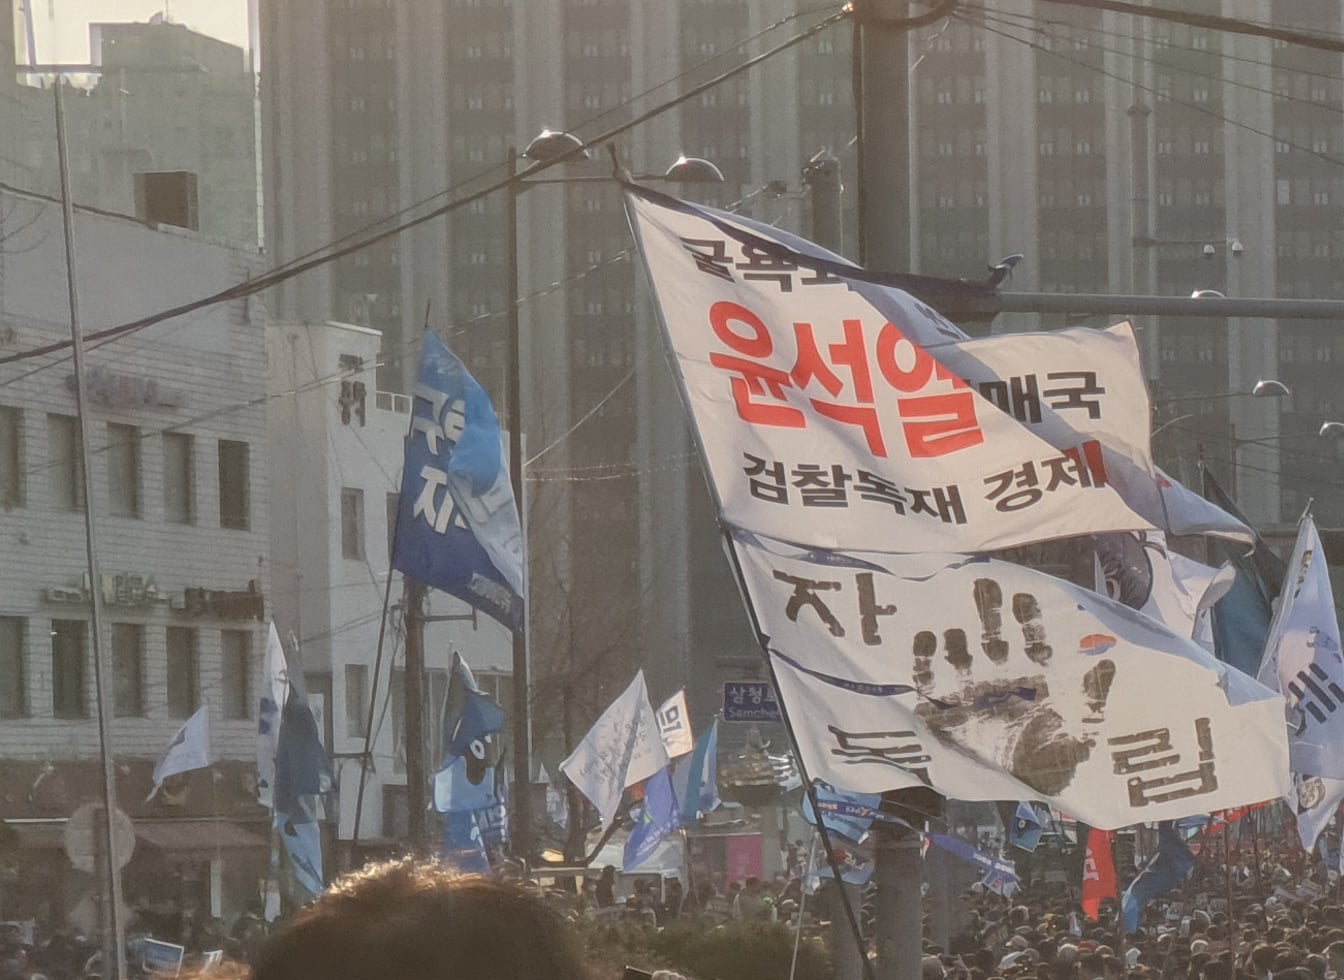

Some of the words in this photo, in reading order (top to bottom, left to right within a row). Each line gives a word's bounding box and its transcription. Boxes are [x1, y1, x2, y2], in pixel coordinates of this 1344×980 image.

[708, 299, 985, 458] 윤석열
[742, 451, 967, 525] 검찰독재
[983, 439, 1108, 512] 경제
[771, 570, 898, 646] 자
